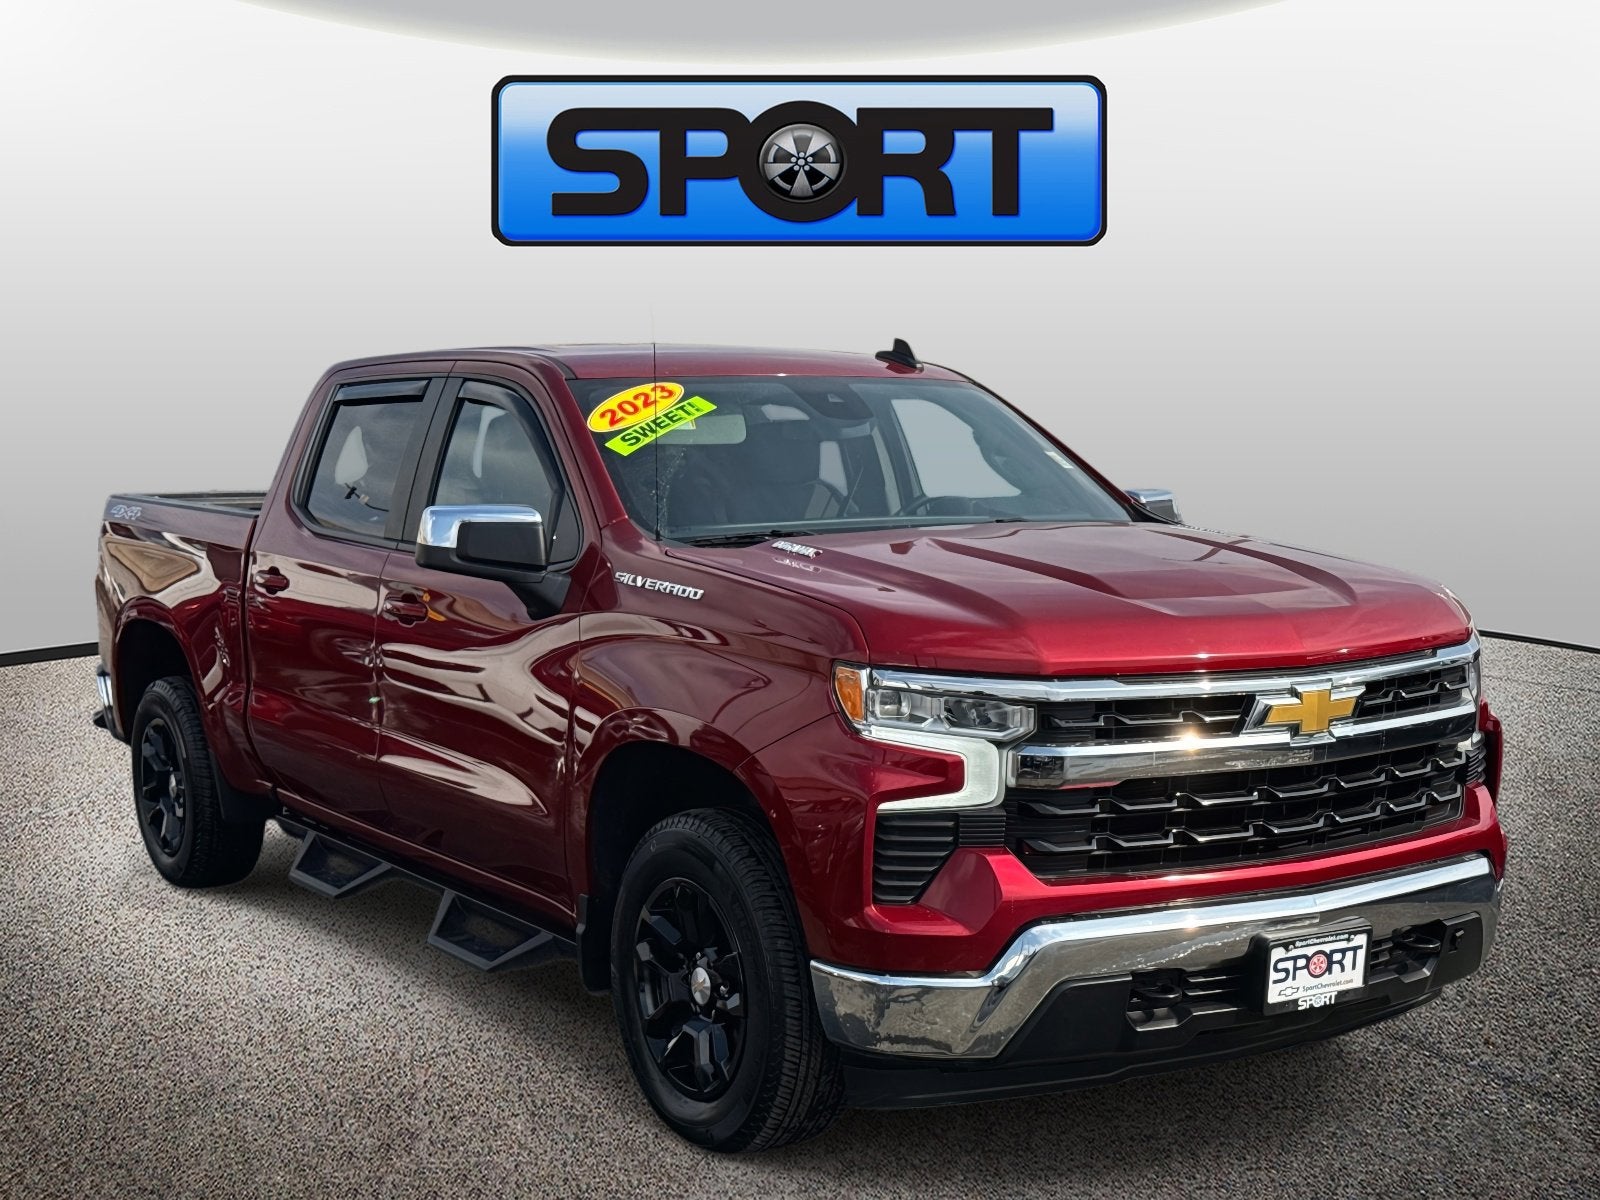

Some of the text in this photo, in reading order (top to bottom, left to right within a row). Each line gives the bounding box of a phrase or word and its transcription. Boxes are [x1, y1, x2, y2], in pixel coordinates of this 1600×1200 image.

[599, 384, 675, 428] 2023
[620, 401, 701, 446] SWEET!
[614, 571, 704, 600] SILVERADO
[1295, 933, 1349, 948] SportChevrolet.com
[1272, 945, 1363, 984] SPORT
[1302, 978, 1354, 992] SportChevrolet.com
[1298, 992, 1337, 1010] SPORT
